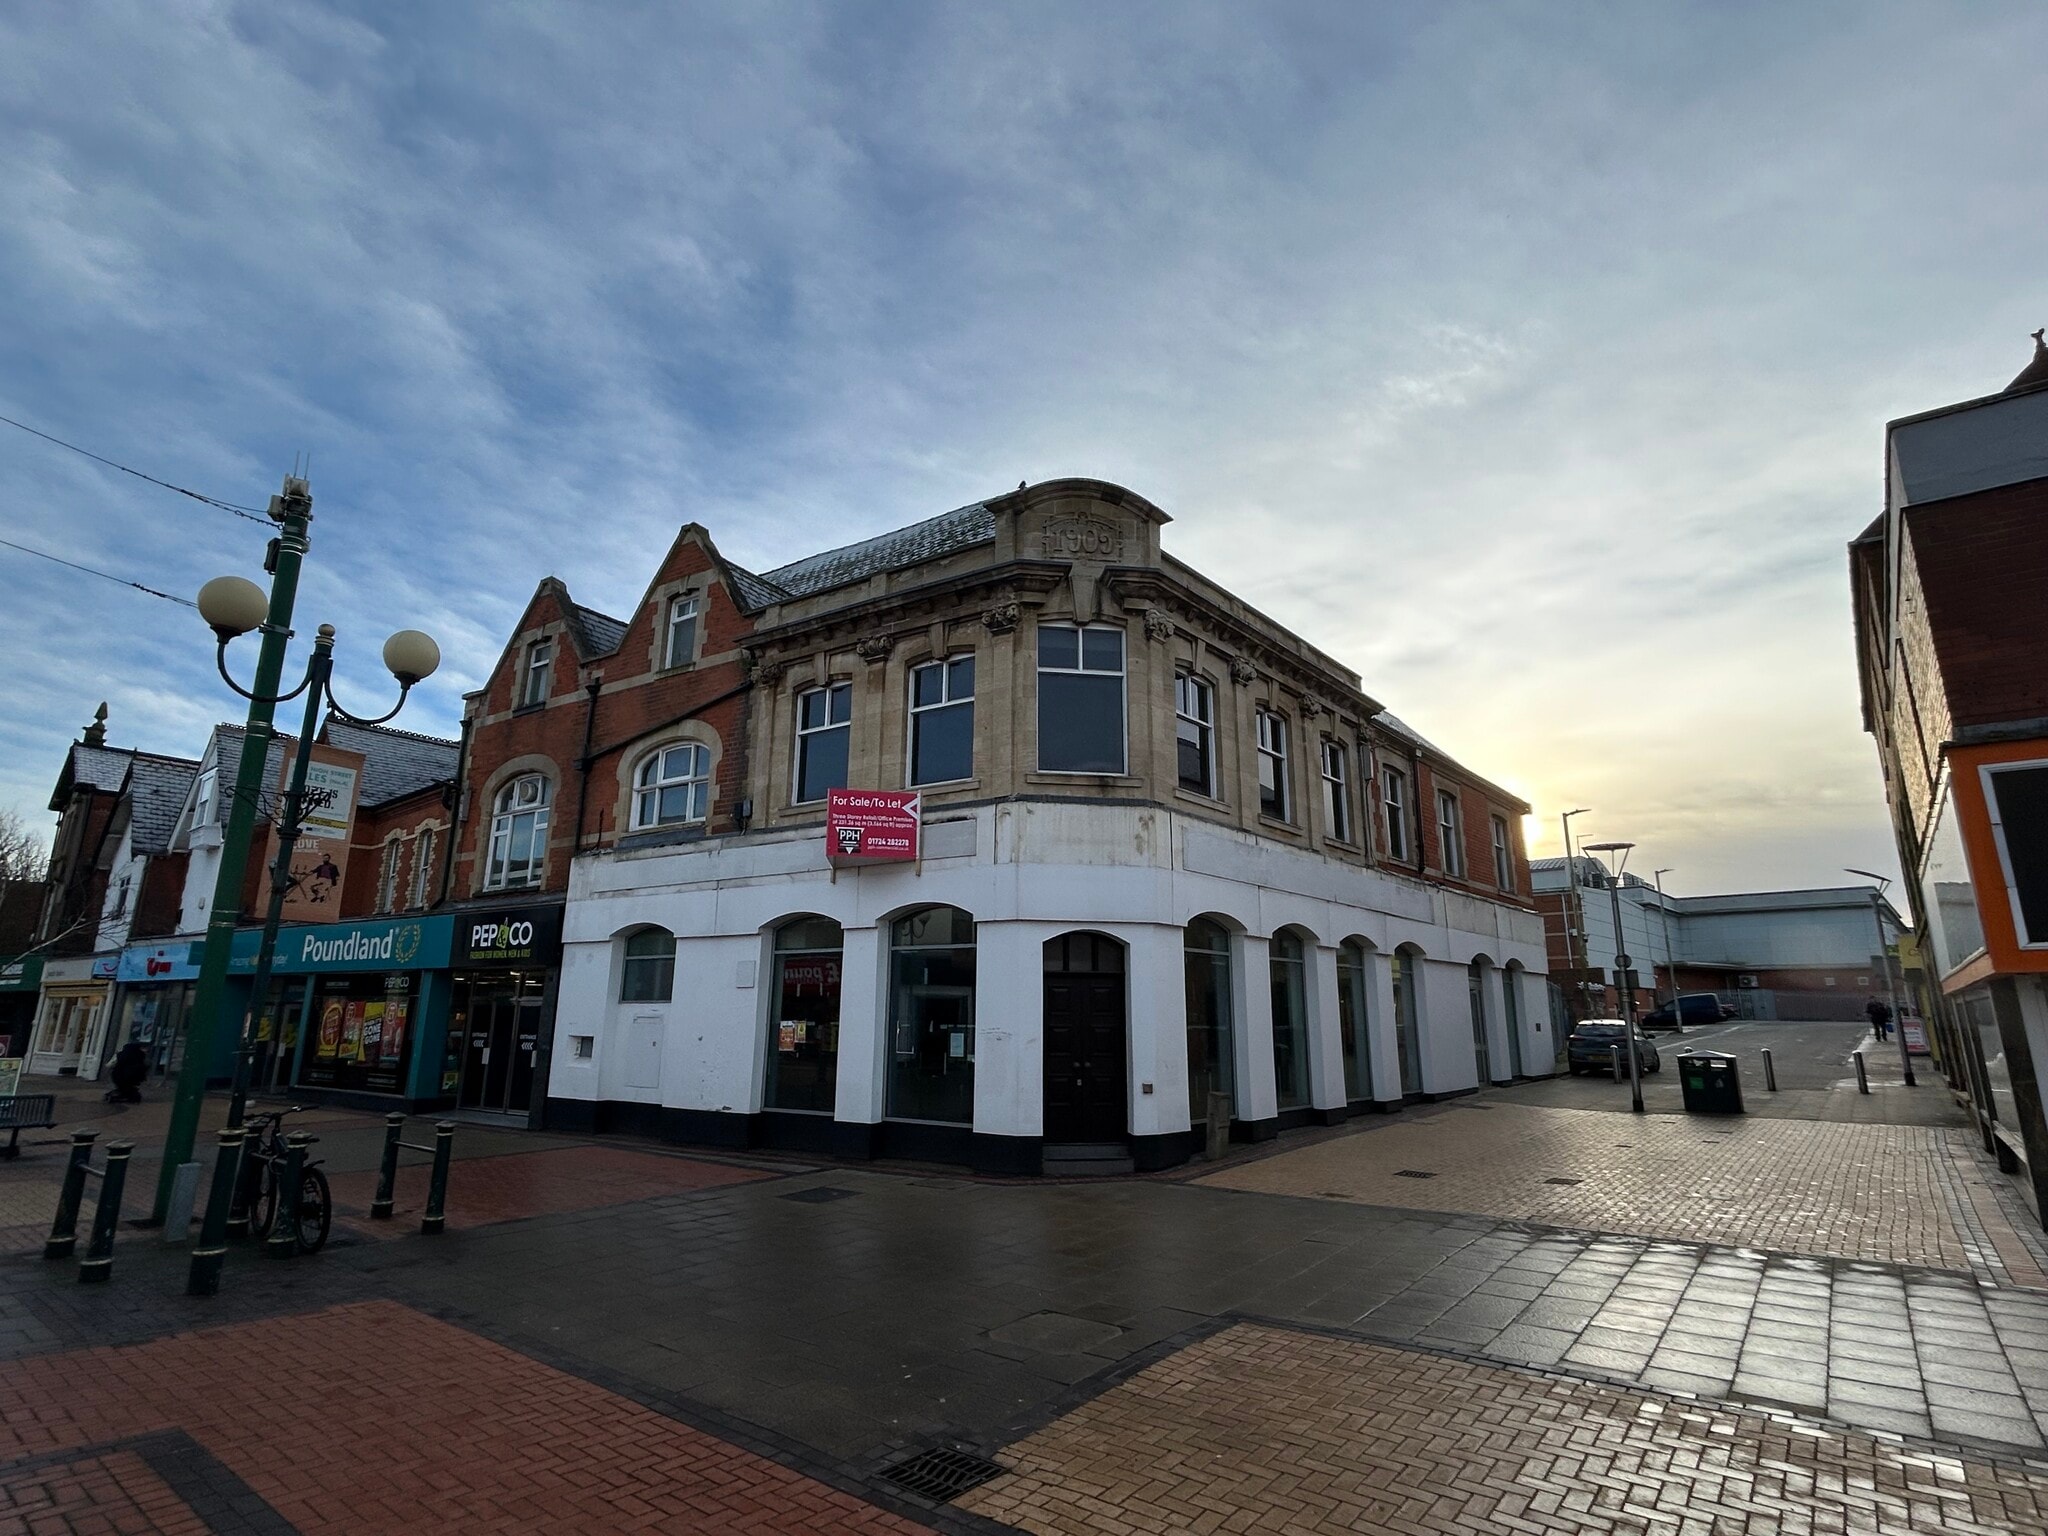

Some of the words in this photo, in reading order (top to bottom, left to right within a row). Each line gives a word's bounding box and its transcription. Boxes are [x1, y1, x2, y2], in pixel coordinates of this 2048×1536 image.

[1052, 528, 1114, 555] 1909
[832, 796, 848, 804] For
[849, 796, 885, 808] Sale/To
[887, 800, 902, 808] Let
[839, 830, 860, 840] PPH
[867, 838, 886, 846] 01724
[301, 928, 394, 963] Poundland
